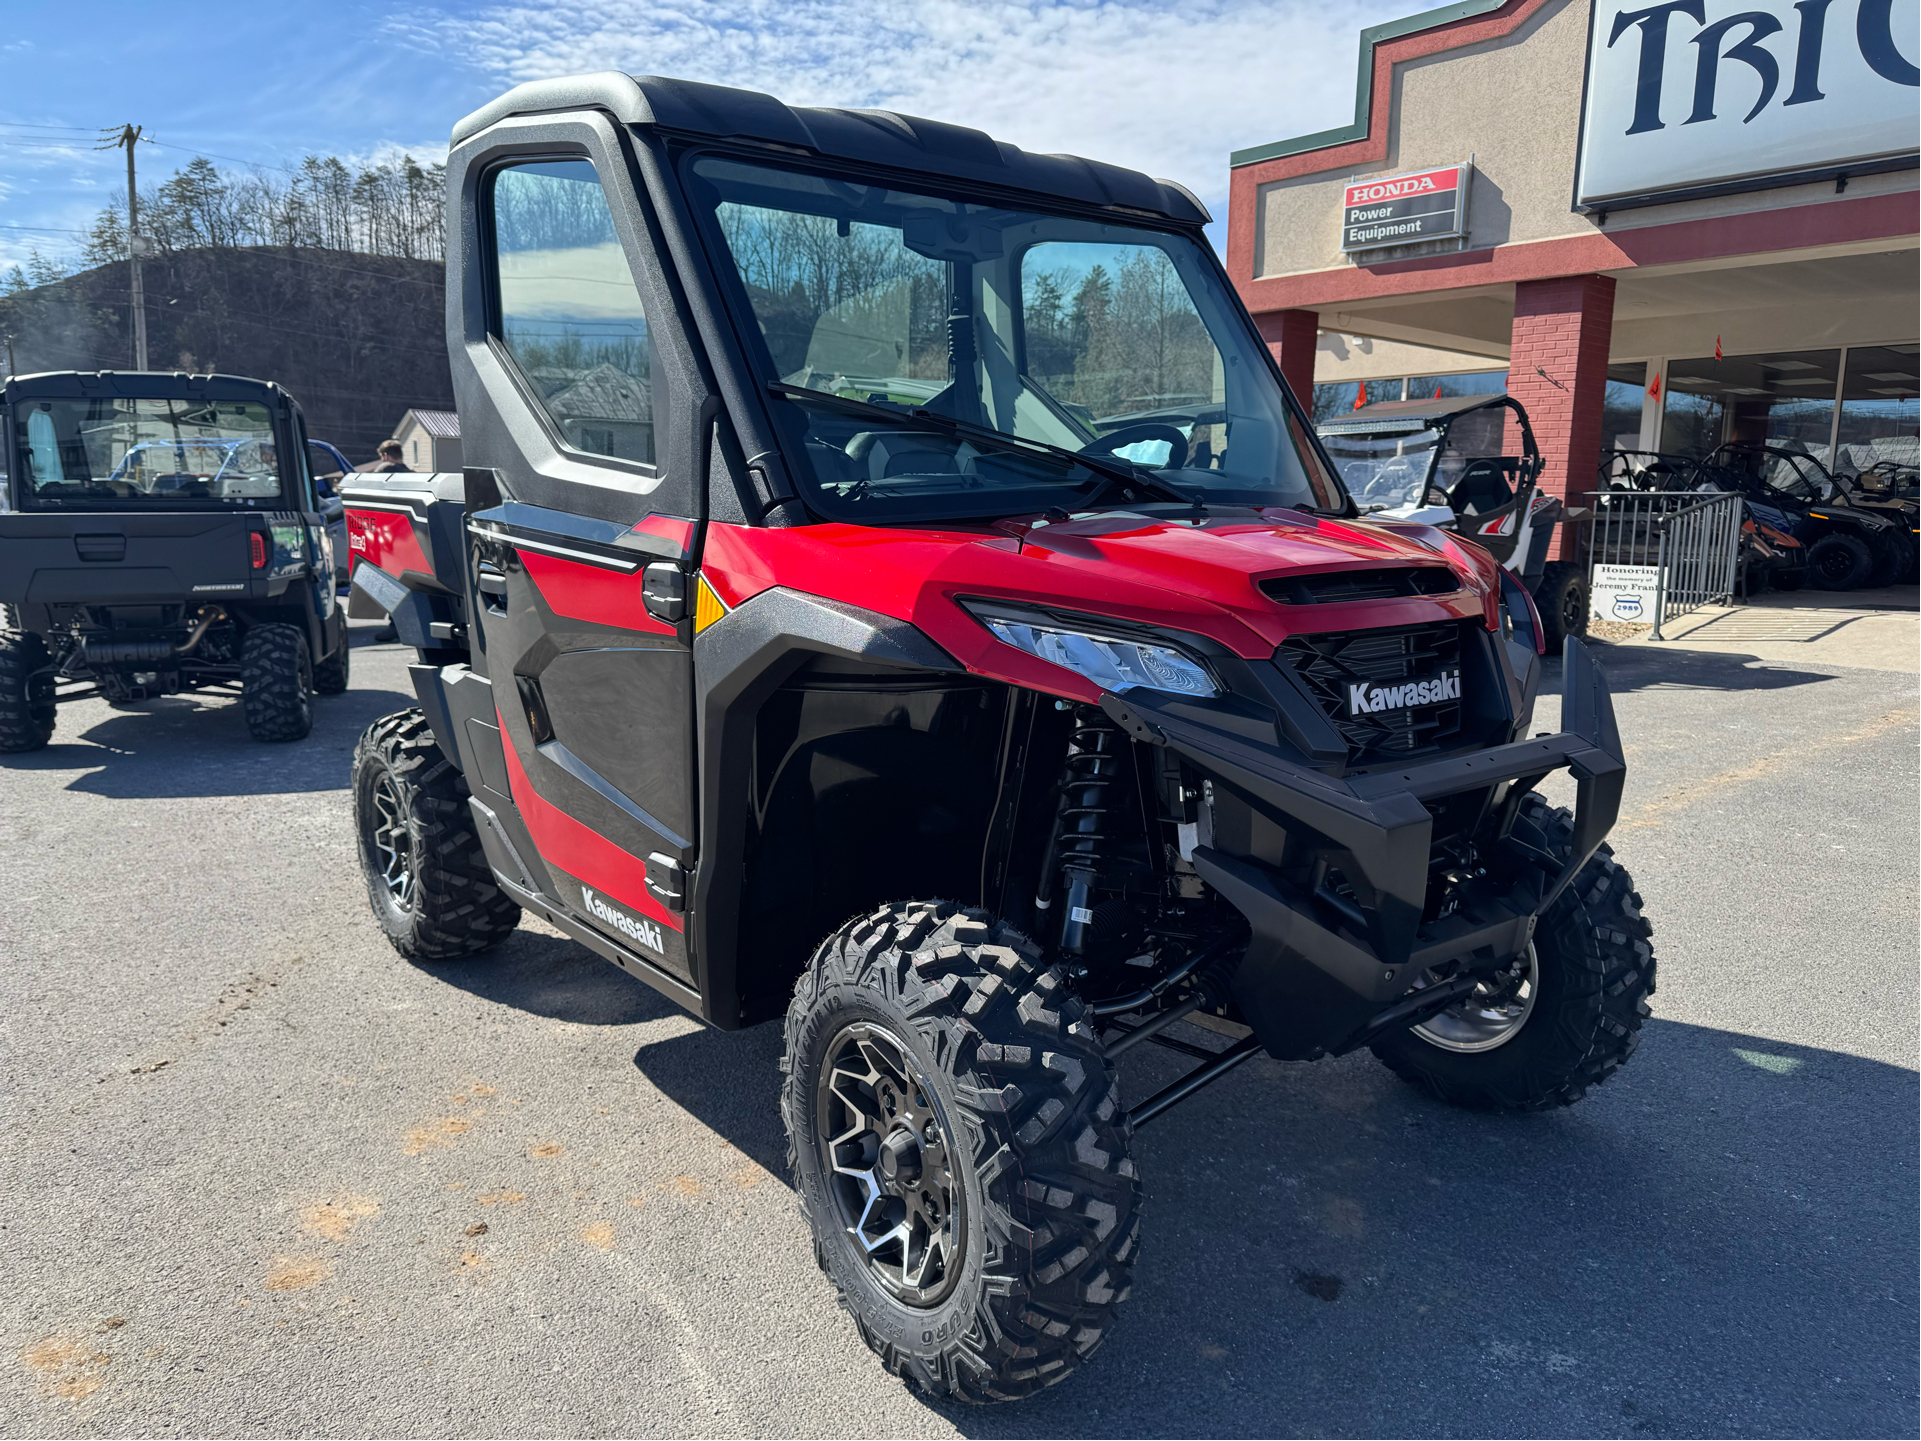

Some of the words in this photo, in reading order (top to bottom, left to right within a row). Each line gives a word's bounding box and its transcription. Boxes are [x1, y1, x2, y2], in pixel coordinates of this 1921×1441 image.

[1351, 176, 1436, 203] HONDA
[1350, 206, 1393, 223] Power
[1349, 219, 1422, 242] Equipment
[348, 515, 377, 532] RIDGE
[1601, 566, 1659, 575] Honoring
[1593, 582, 1629, 591] Jeremy
[1349, 669, 1462, 716] Kawasaki
[581, 886, 665, 955] Kawasaki
[920, 1285, 971, 1348] DURO
